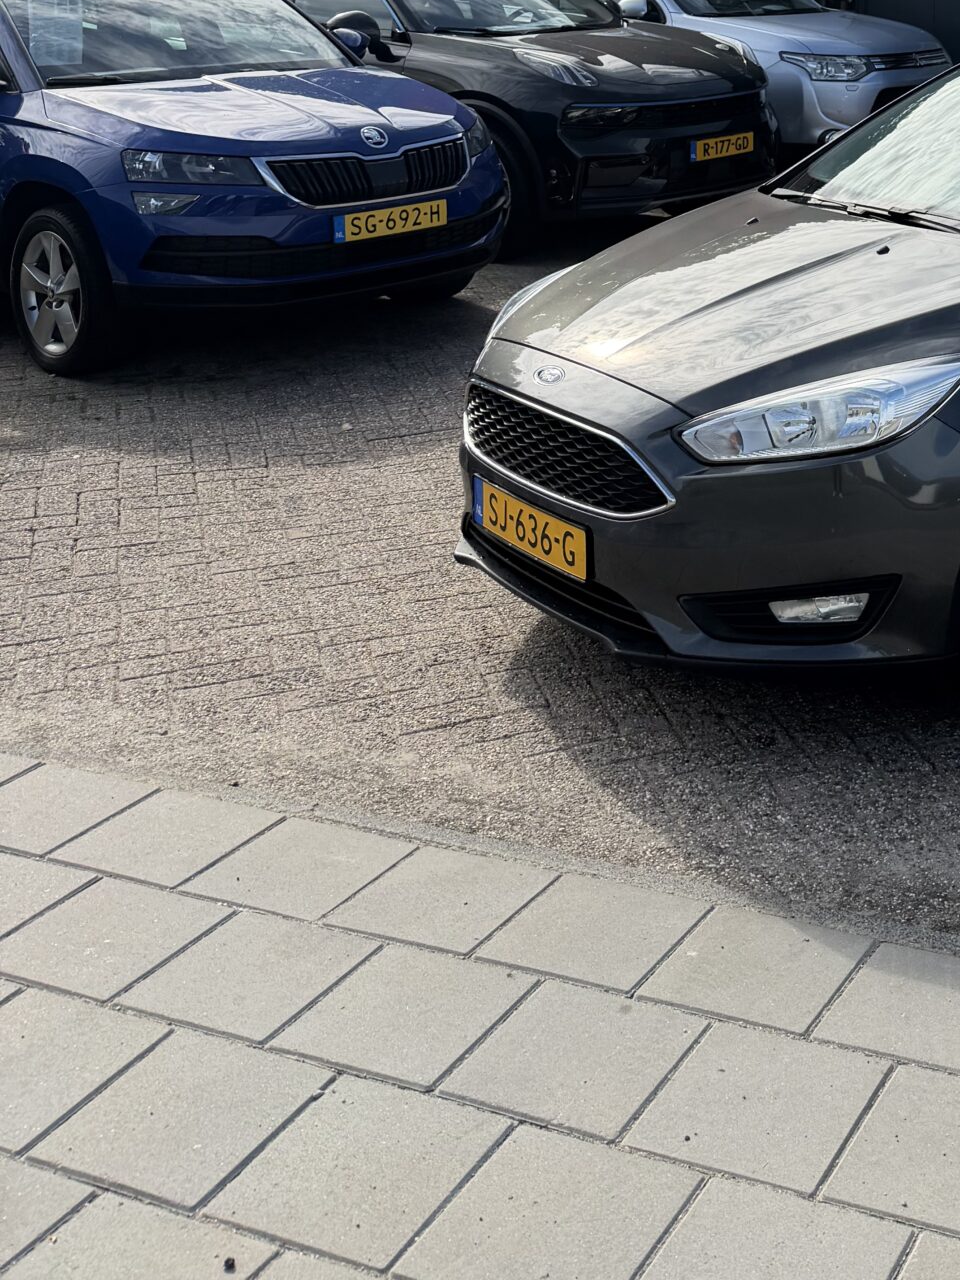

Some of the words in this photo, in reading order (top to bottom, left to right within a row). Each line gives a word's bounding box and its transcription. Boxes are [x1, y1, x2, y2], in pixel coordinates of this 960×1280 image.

[703, 136, 749, 157] R-177-GD
[350, 204, 440, 236] SG-692-H
[488, 493, 576, 567] SJ-636-G
